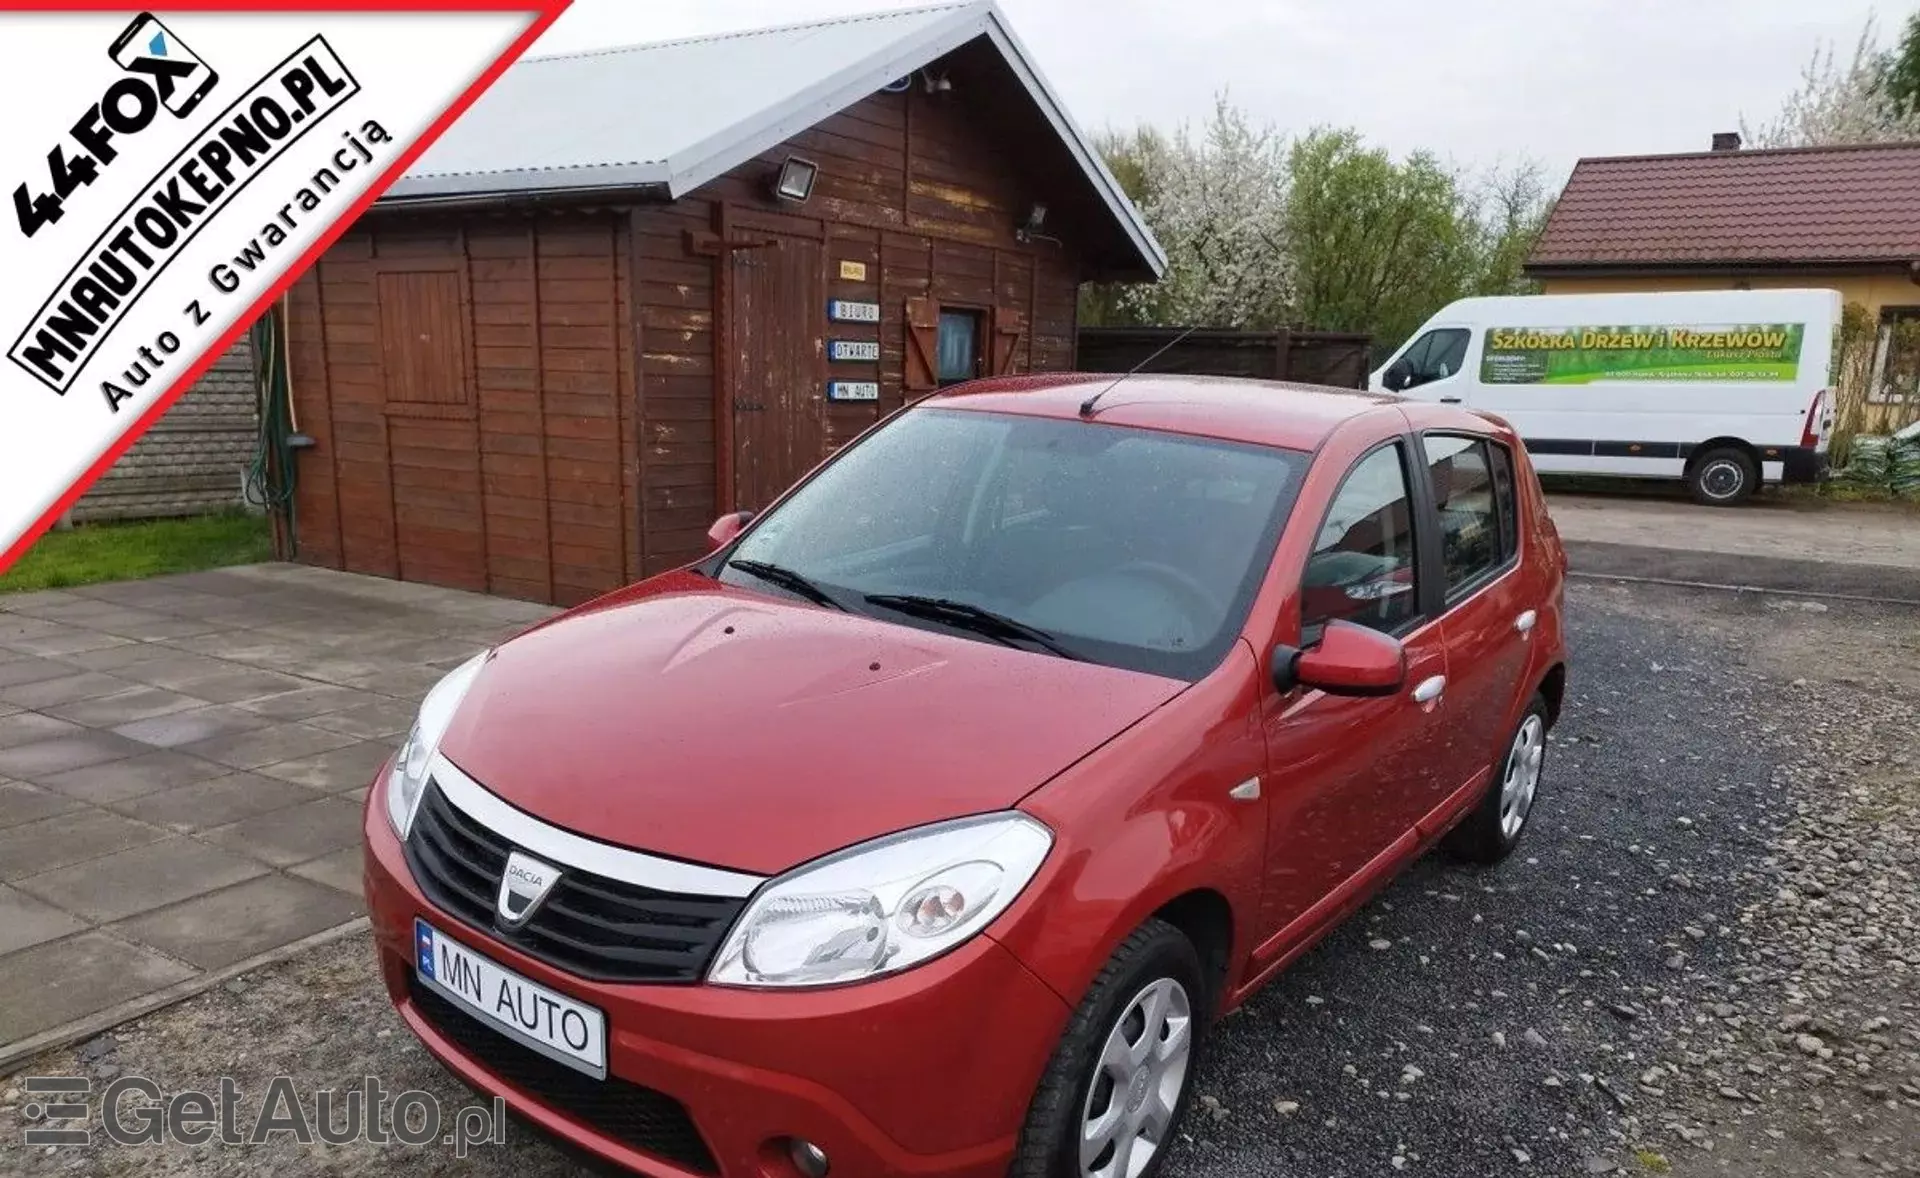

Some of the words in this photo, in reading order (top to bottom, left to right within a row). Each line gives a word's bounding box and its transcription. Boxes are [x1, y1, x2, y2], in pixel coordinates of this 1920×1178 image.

[840, 304, 875, 319] BIURO
[1582, 331, 1653, 349] DRZEW
[837, 344, 878, 358] OTWARTE
[508, 864, 543, 887] DACIA
[441, 943, 482, 1003] MN
[496, 979, 589, 1051] AUTO
